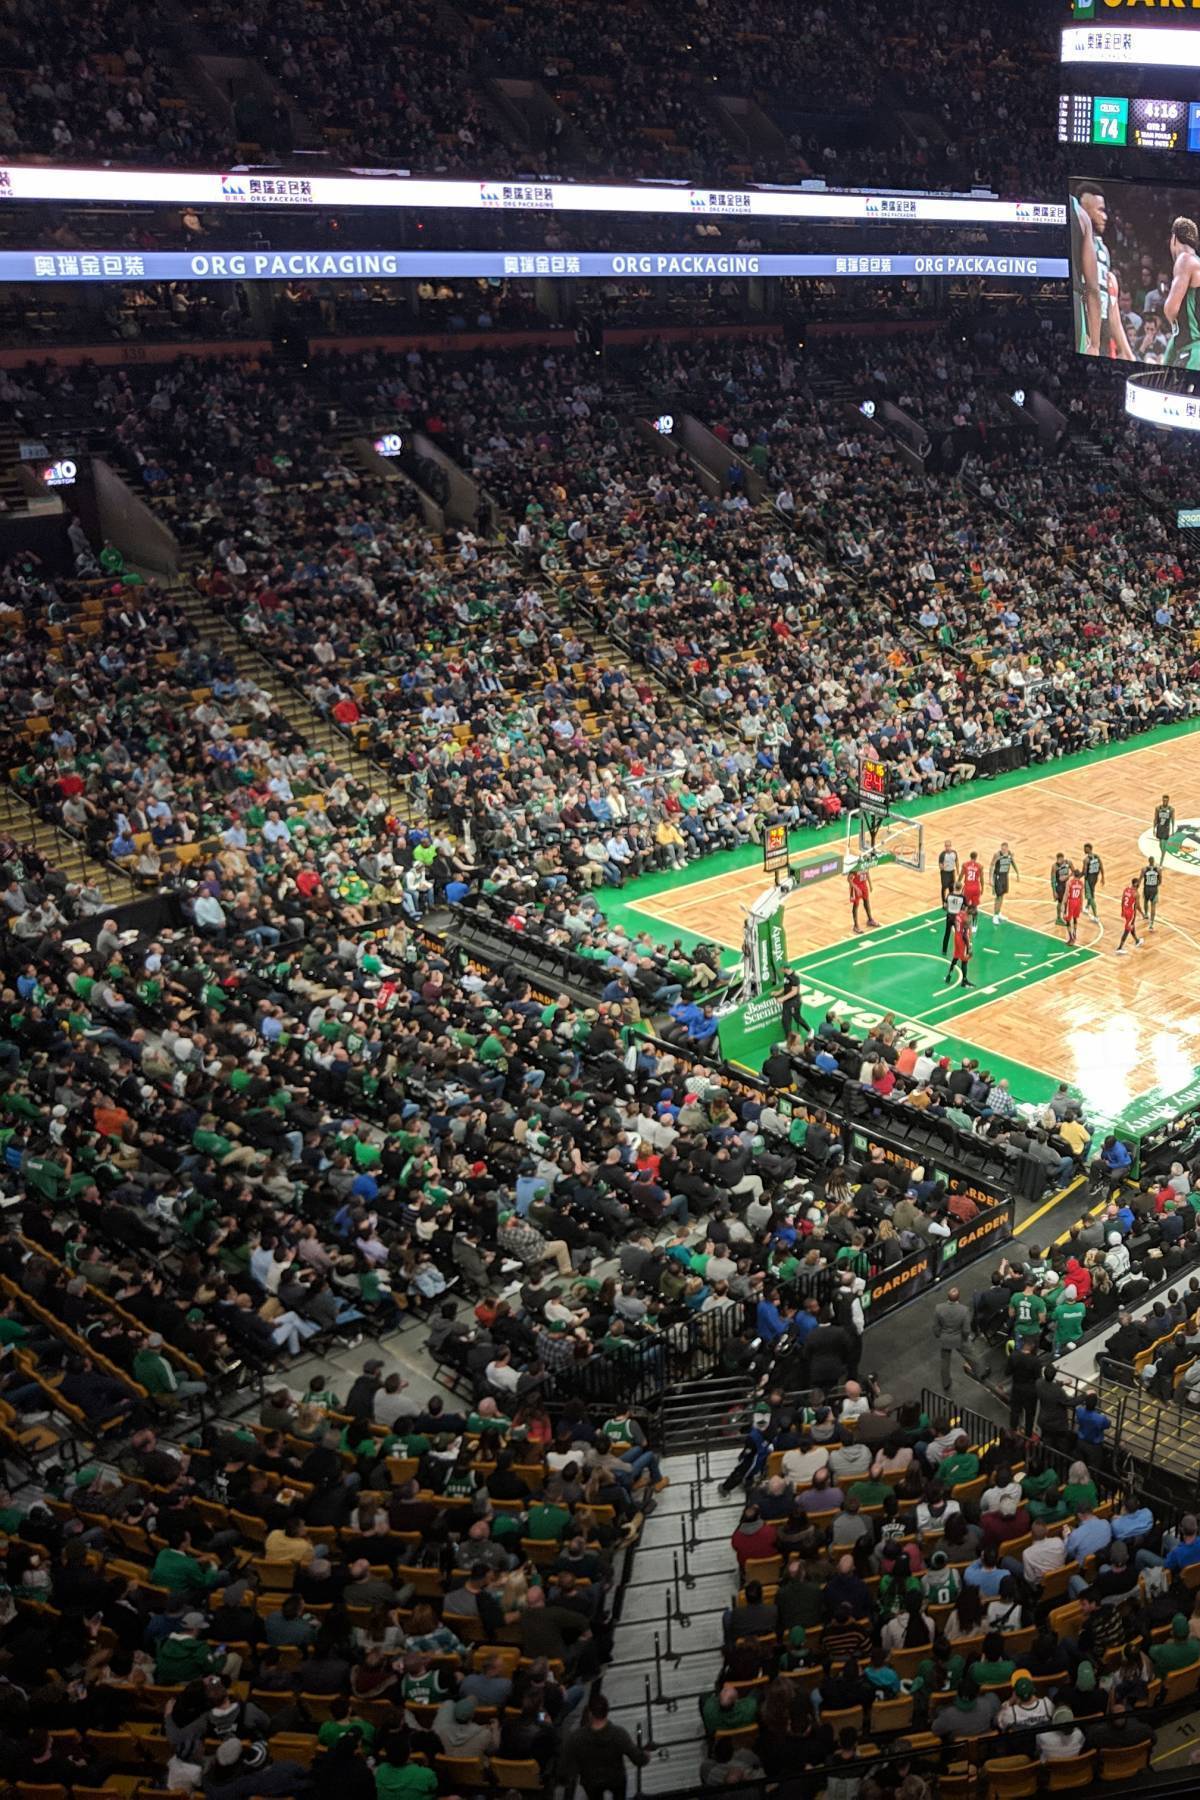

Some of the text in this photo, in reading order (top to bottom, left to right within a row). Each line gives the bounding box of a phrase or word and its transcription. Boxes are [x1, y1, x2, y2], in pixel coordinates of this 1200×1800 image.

[1145, 102, 1178, 119] 4:16
[1101, 119, 1119, 139] 74
[249, 179, 312, 195] 奥瑞金包装
[503, 187, 553, 200] 奥瑞金包装
[35, 256, 145, 276] 奥瑞金包装
[191, 255, 398, 276] ORG PACKAGING
[503, 256, 581, 274] 奥瑞金包装
[612, 256, 759, 274] ORG PACKAGING
[836, 258, 892, 273] 奥瑞金包装
[915, 258, 1038, 274] ORG PACKAGING
[660, 415, 674, 430] 10
[384, 434, 402, 452] 10
[55, 460, 77, 479] 10
[864, 771, 884, 793] 24
[968, 872, 976, 881] 21
[1072, 889, 1080, 898] 10
[1124, 896, 1129, 906] 2
[747, 998, 776, 1013] Boston
[958, 1212, 1009, 1248] GARDEN
[872, 1259, 928, 1299] GARDEN
[938, 1588, 950, 1605] 0
